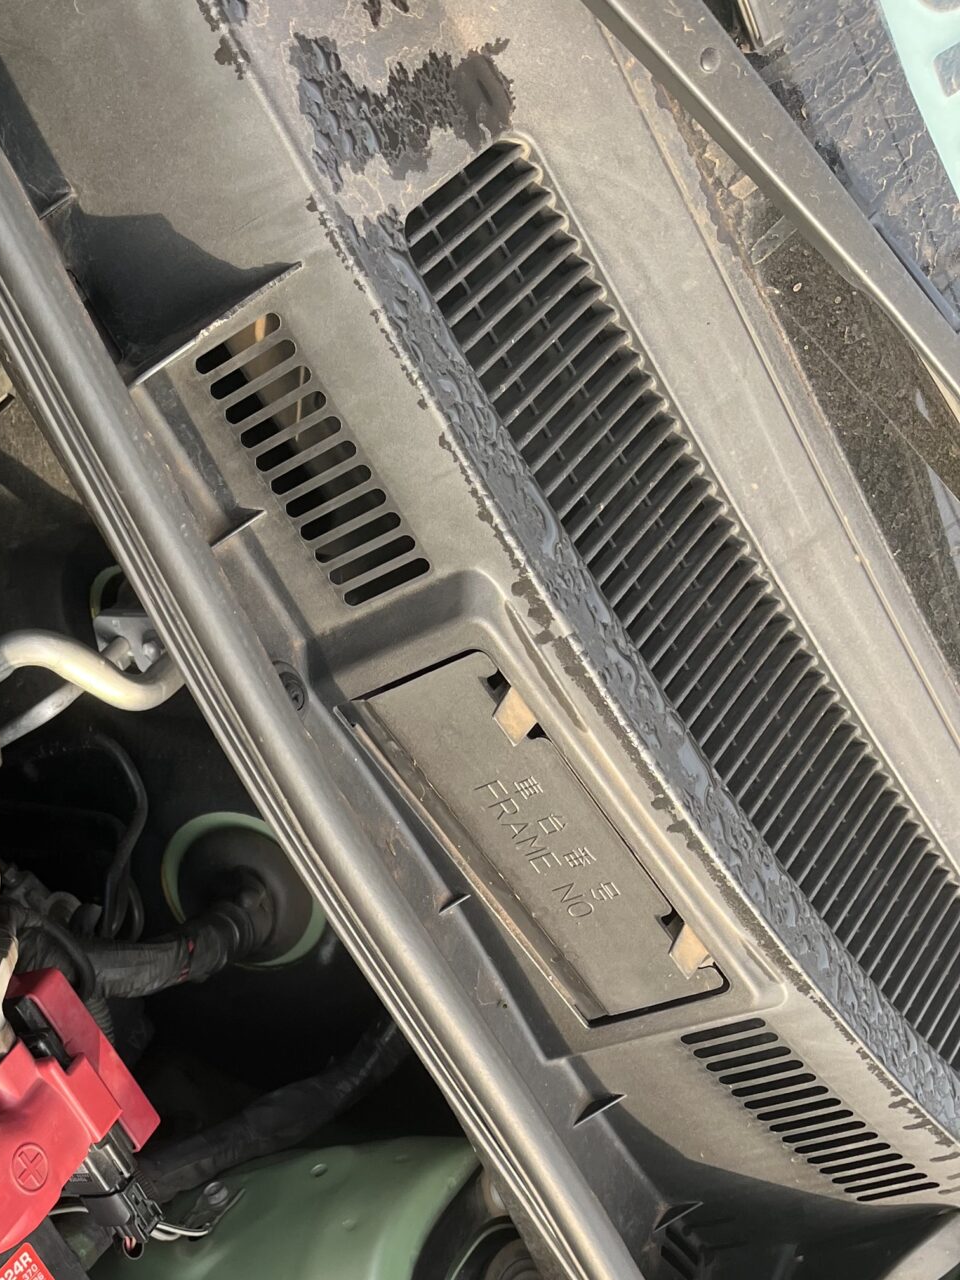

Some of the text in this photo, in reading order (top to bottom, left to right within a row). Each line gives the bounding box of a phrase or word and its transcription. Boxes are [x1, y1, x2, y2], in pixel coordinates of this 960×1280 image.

[473, 779, 562, 875] FRAME
[514, 775, 621, 903] 車台番号
